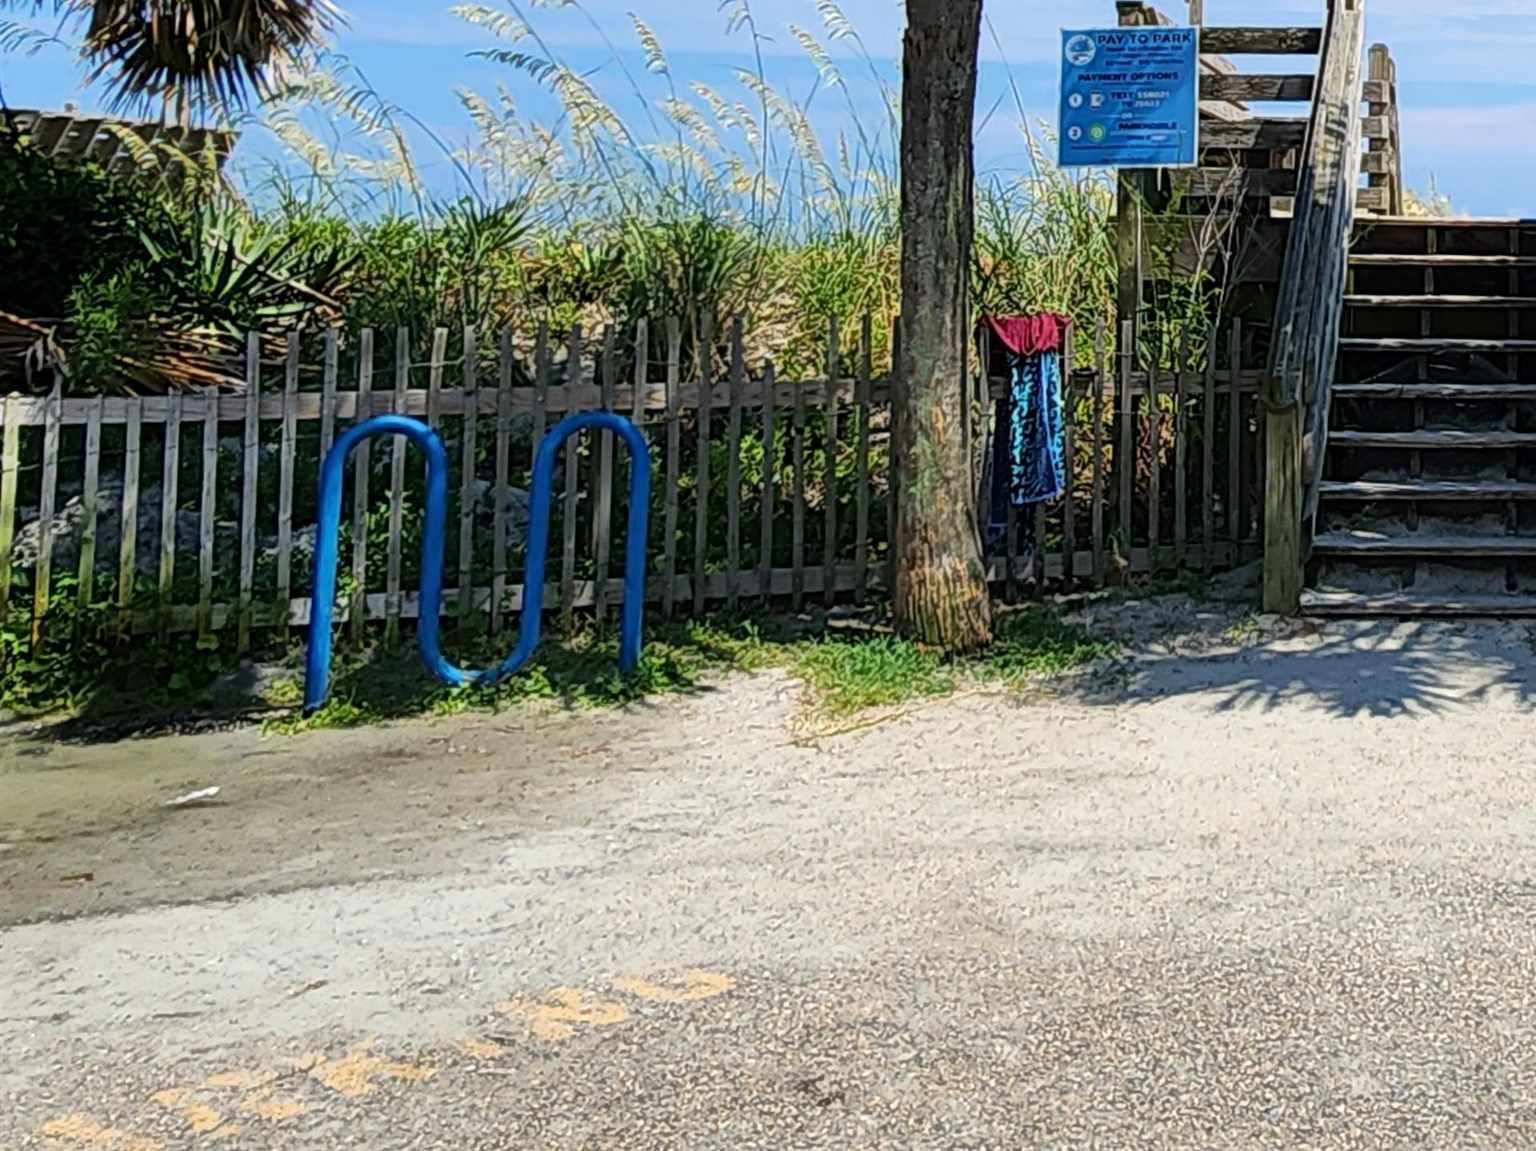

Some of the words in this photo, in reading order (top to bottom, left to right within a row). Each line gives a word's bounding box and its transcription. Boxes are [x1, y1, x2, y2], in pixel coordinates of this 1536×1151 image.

[1098, 35, 1125, 45] PAY
[1131, 34, 1149, 44] TO
[1153, 32, 1191, 43] PARK
[1078, 73, 1128, 82] PAYMENT
[1131, 72, 1178, 81] OPTIONS
